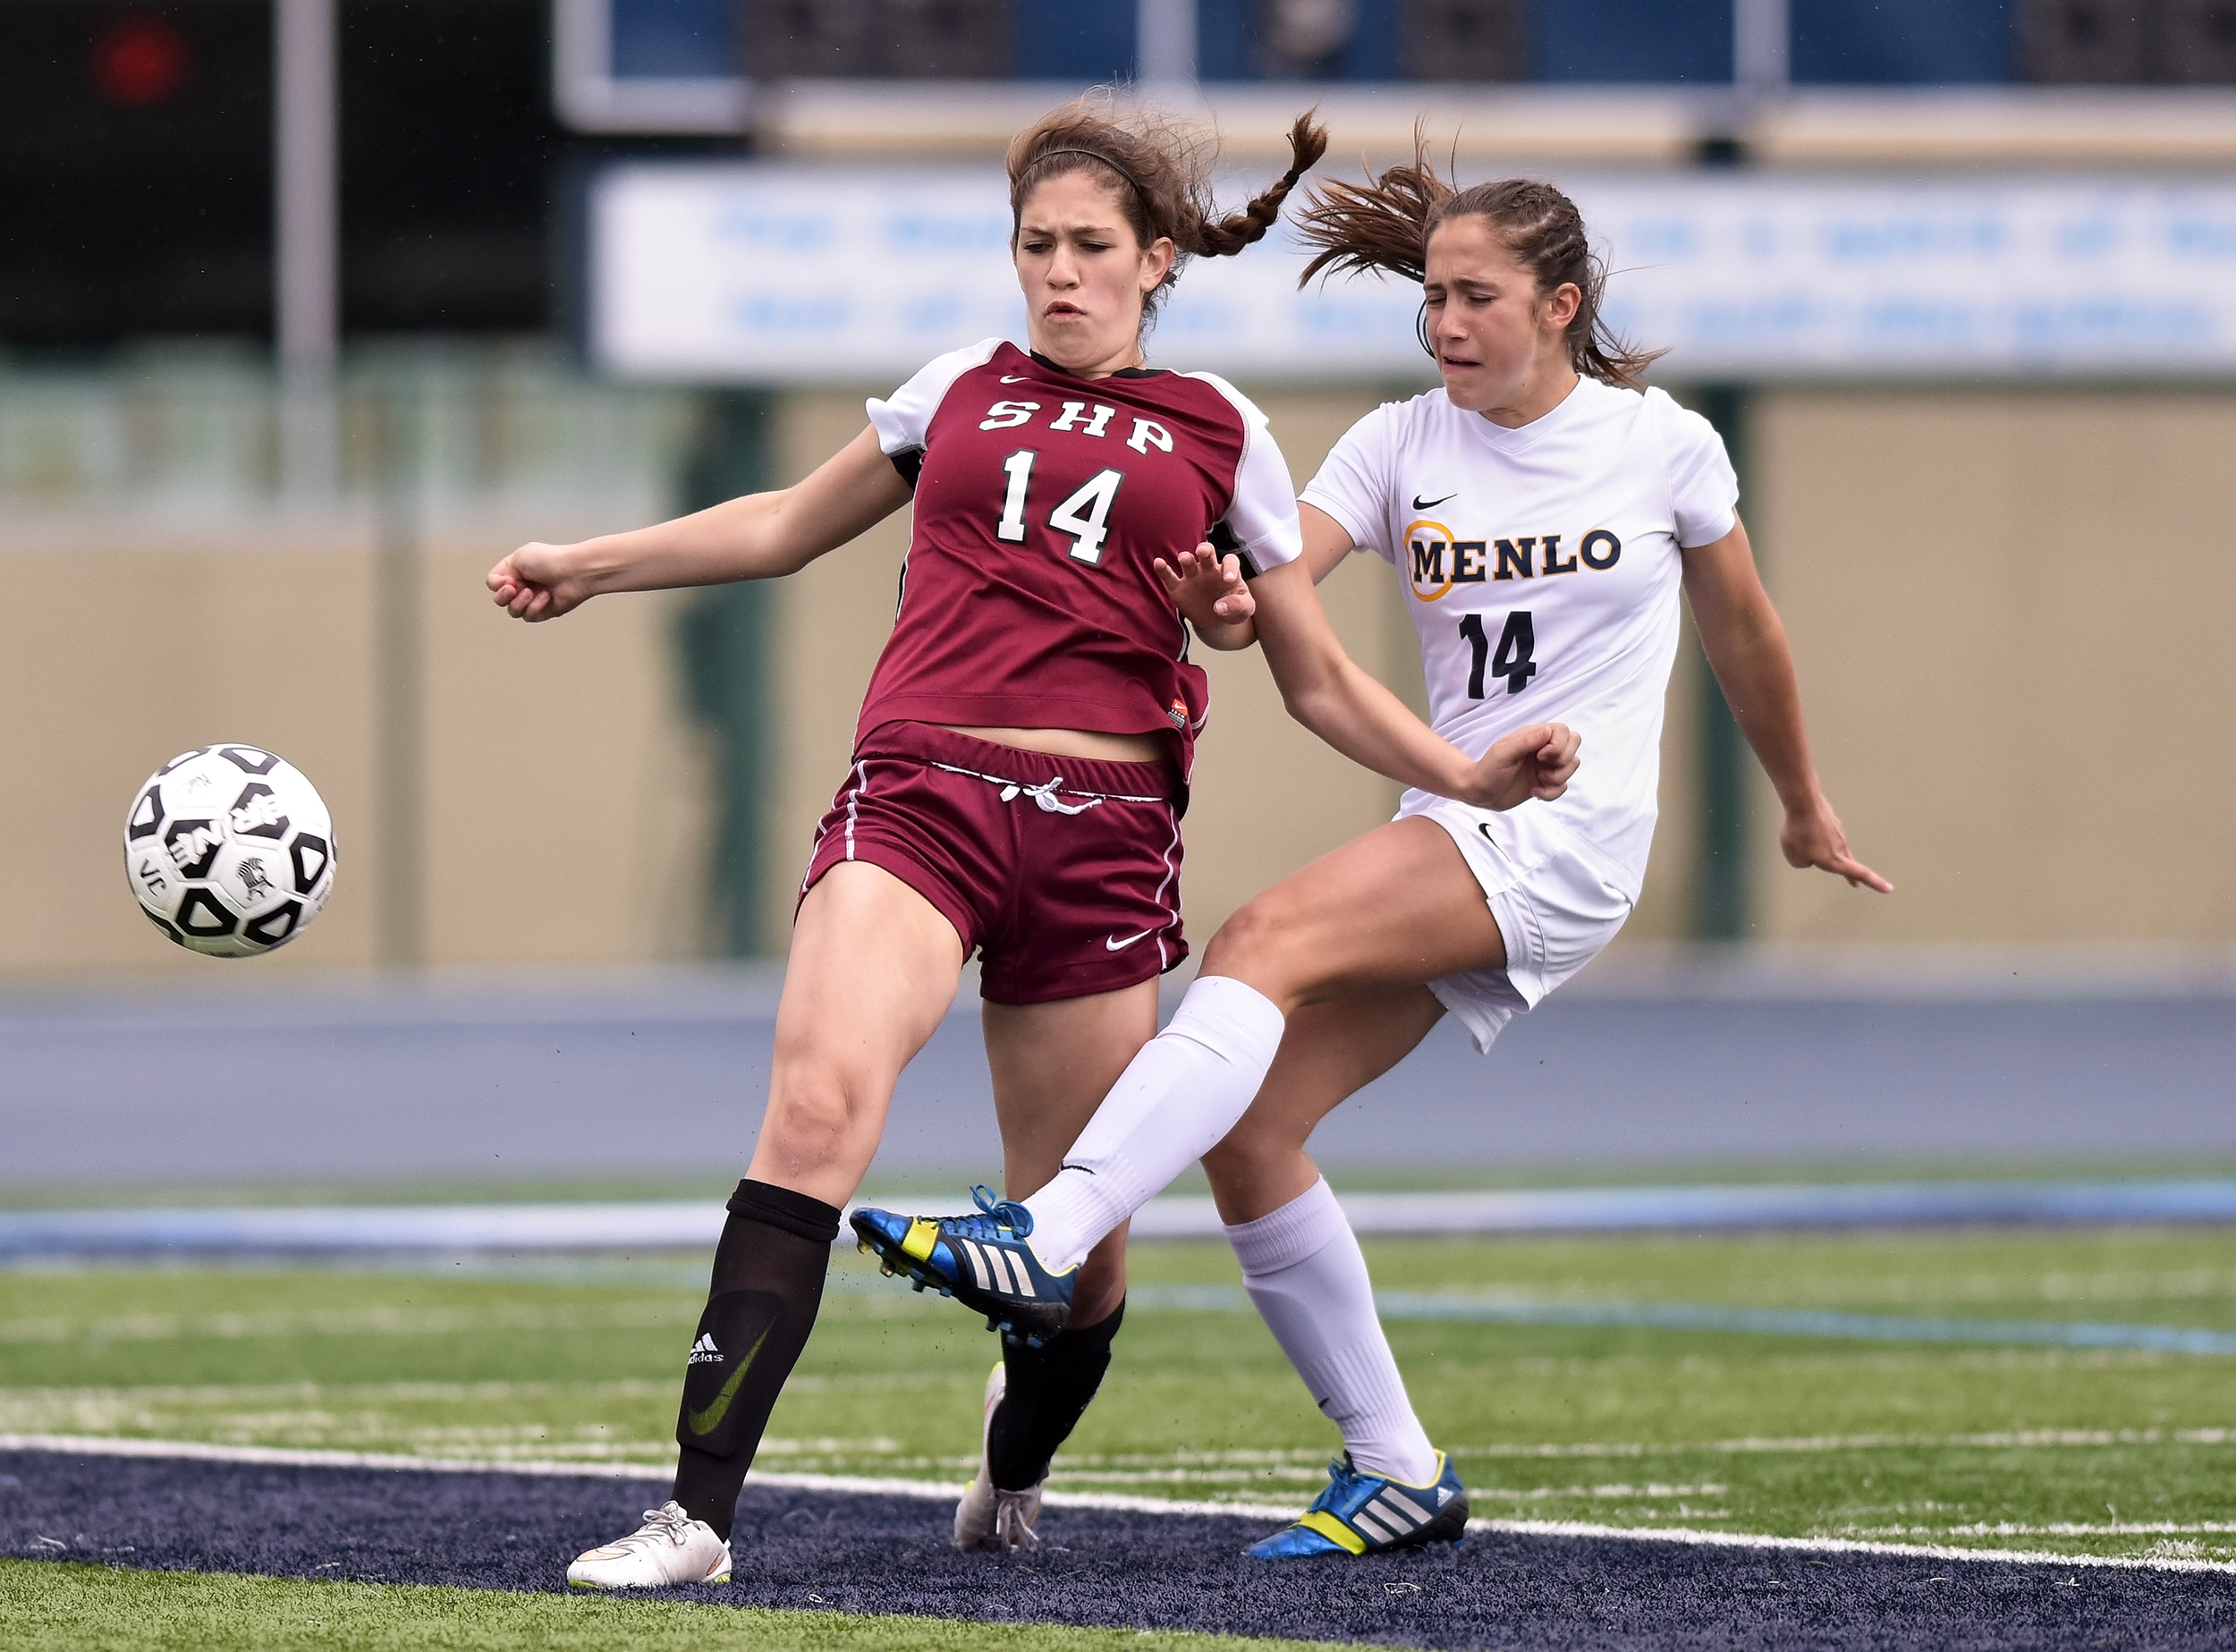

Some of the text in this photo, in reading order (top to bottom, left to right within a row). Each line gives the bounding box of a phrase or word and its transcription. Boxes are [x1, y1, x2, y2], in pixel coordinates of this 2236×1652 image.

[978, 400, 1174, 455] SHP
[995, 447, 1126, 566] 14
[1410, 529, 1622, 584] MENLO
[1458, 610, 1537, 699] 14
